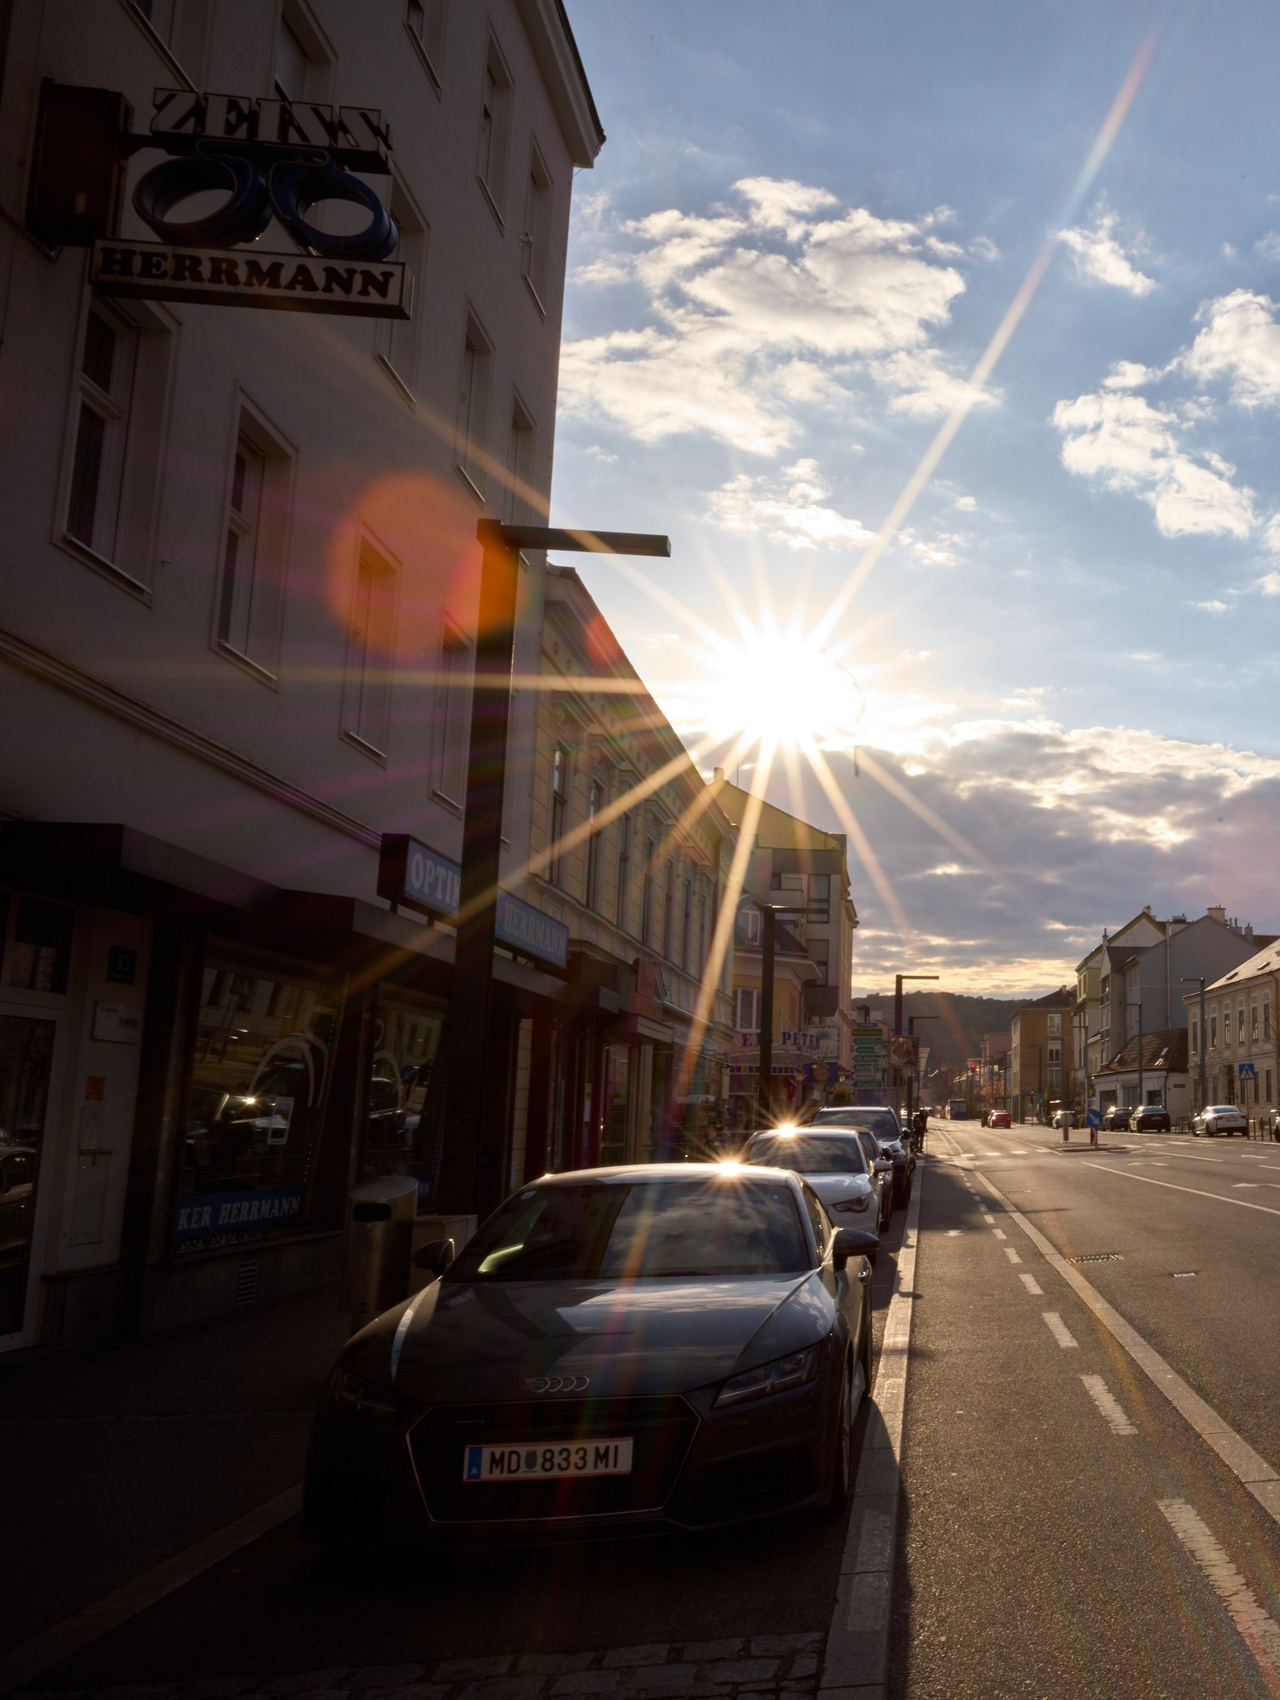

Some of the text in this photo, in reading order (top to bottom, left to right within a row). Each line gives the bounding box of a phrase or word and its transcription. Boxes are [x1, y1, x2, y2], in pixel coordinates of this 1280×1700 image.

[98, 246, 396, 299] HERRMANN
[503, 900, 566, 958] HERRMANN
[780, 1030, 820, 1049] PETER
[177, 1195, 302, 1231] KER HERRMANN
[489, 1450, 520, 1475] MD
[540, 1446, 587, 1472] 833
[593, 1444, 617, 1470] MI
